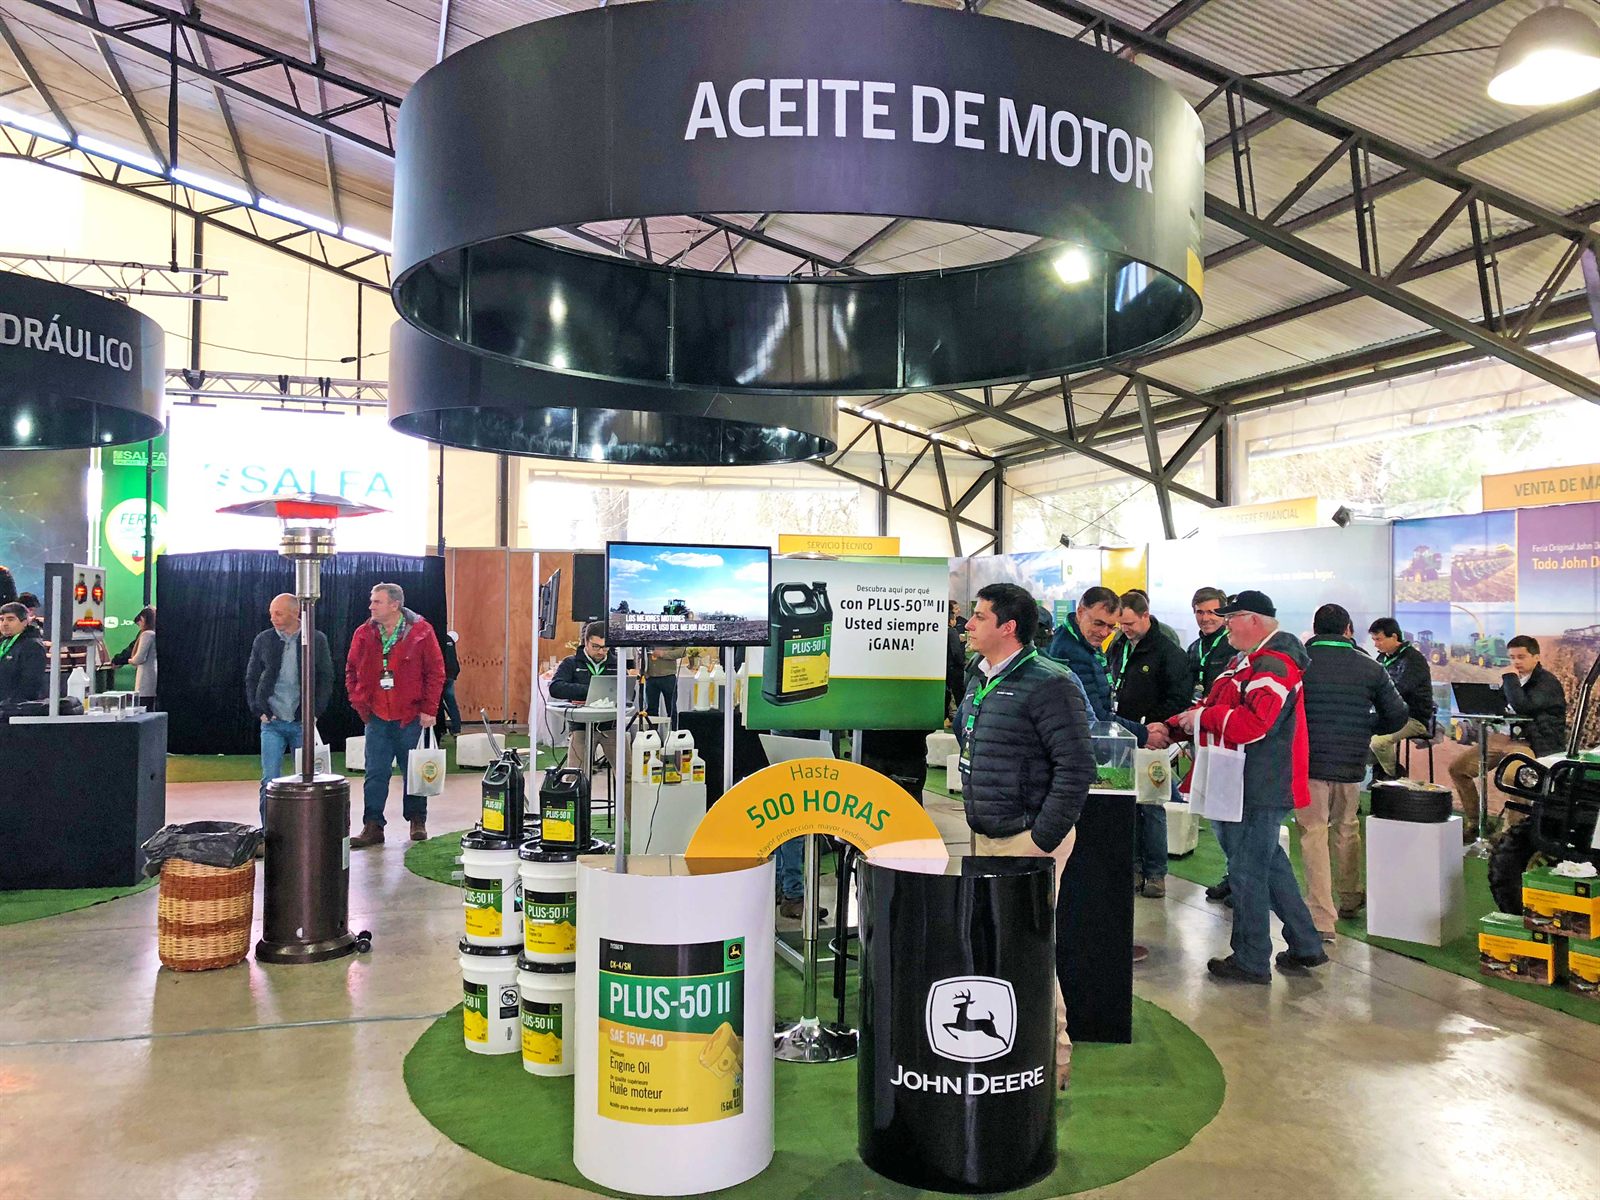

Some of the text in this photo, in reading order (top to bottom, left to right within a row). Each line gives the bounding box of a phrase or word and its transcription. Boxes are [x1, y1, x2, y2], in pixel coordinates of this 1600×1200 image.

[684, 78, 1154, 193] ACEITE DE MOTOR
[0, 312, 133, 371] DRÁULICO
[1514, 481, 1556, 497] VENTA
[1560, 478, 1577, 493] DE
[120, 513, 158, 526] FERA
[807, 541, 840, 550] SERVICIO
[1532, 544, 1548, 553] Feria
[1576, 542, 1593, 551] John
[1532, 556, 1558, 570] Todo
[1561, 555, 1588, 569] John
[856, 584, 930, 595] Descubra aquí por qué
[840, 599, 863, 610] con
[936, 600, 945, 613] II
[625, 614, 685, 622] LOS MEJORES MOTORES
[625, 623, 651, 631] MERECEN
[651, 623, 658, 631] EL
[659, 623, 669, 631] USO
[670, 623, 680, 631] DEL
[681, 623, 697, 631] MEJOR
[845, 617, 939, 635] Usted siempre
[791, 640, 821, 655] PLUS-50
[868, 637, 915, 651] ¡GANA!
[790, 763, 840, 781] Hasta
[545, 810, 566, 819] PLUS-50
[746, 789, 891, 832] 500 HORAS
[817, 823, 841, 831] mayor
[527, 904, 561, 919] PLUS-50
[610, 980, 731, 1020] PLUS-50 II
[547, 1018, 554, 1030] II
[609, 1028, 664, 1047] SAE 15W-40
[610, 1055, 650, 1074] Engine Oil
[890, 1065, 1045, 1095] JOHN DEERE
[609, 1080, 663, 1100] Huile moteur
